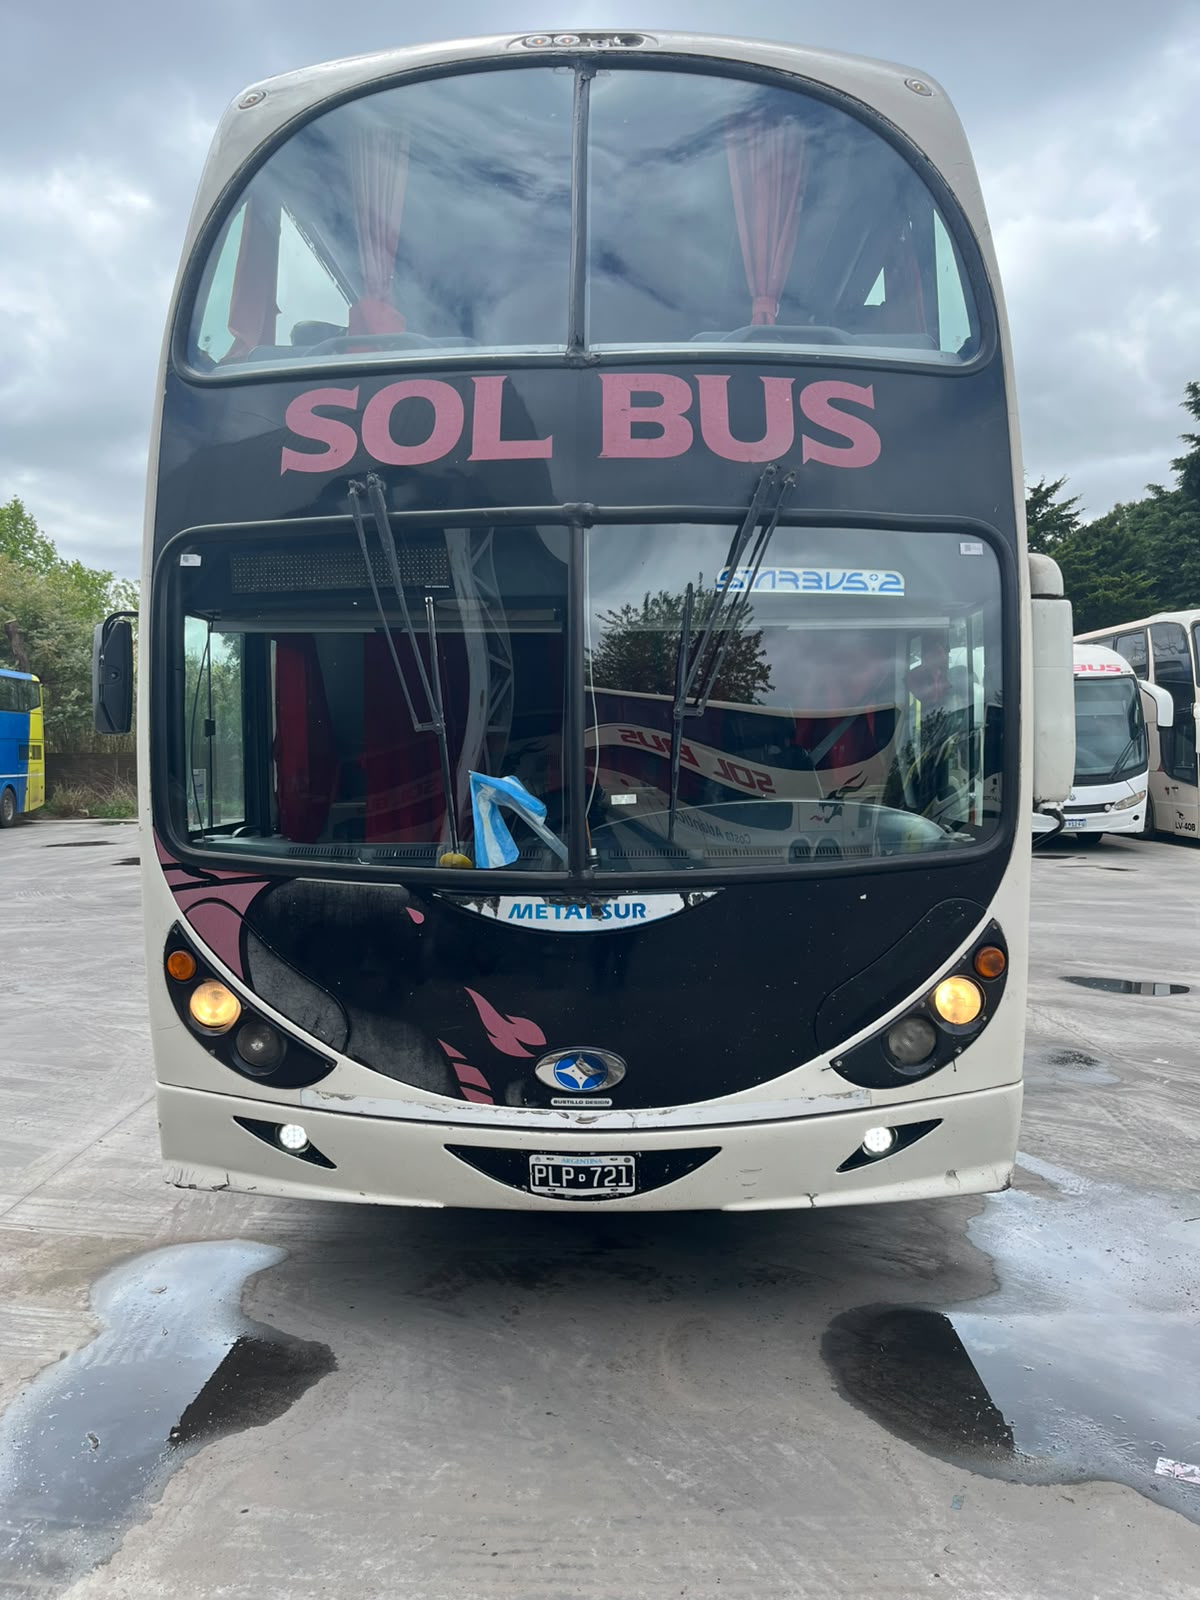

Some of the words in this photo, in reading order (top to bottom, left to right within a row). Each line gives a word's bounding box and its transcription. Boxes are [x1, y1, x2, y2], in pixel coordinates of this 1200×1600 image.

[280, 374, 553, 476] SOL
[598, 372, 881, 468] BUS
[509, 903, 645, 919] METALSUR
[590, 1166, 630, 1187] 721
